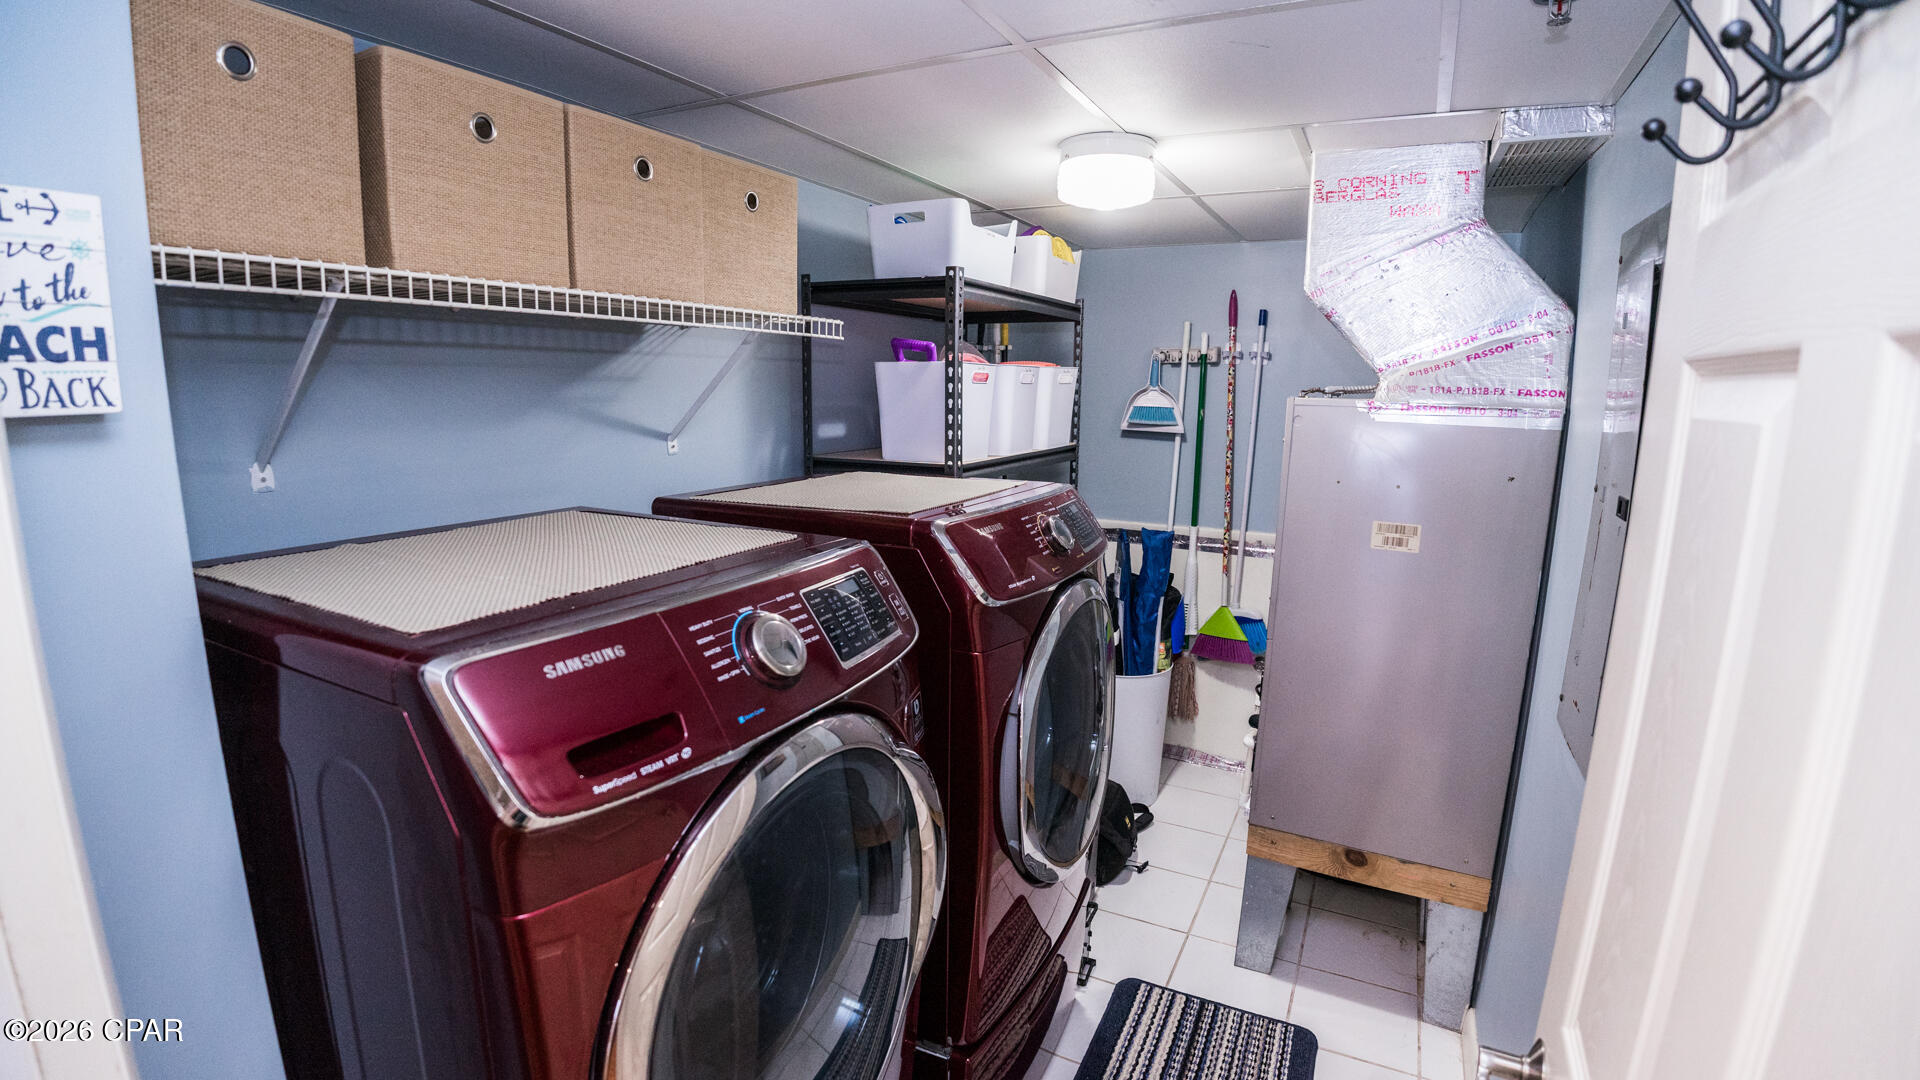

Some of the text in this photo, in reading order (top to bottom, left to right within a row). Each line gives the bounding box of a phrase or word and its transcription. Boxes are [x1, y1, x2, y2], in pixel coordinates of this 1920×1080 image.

[1337, 172, 1427, 189] CORNING
[12, 262, 91, 311] to the
[1465, 341, 1515, 363] FASSON
[13, 368, 116, 410] BACK
[1517, 389, 1566, 399] FASSON
[543, 644, 626, 679] SAMSUNG
[592, 771, 638, 795] SuperSpeed
[640, 760, 664, 776] STEAM
